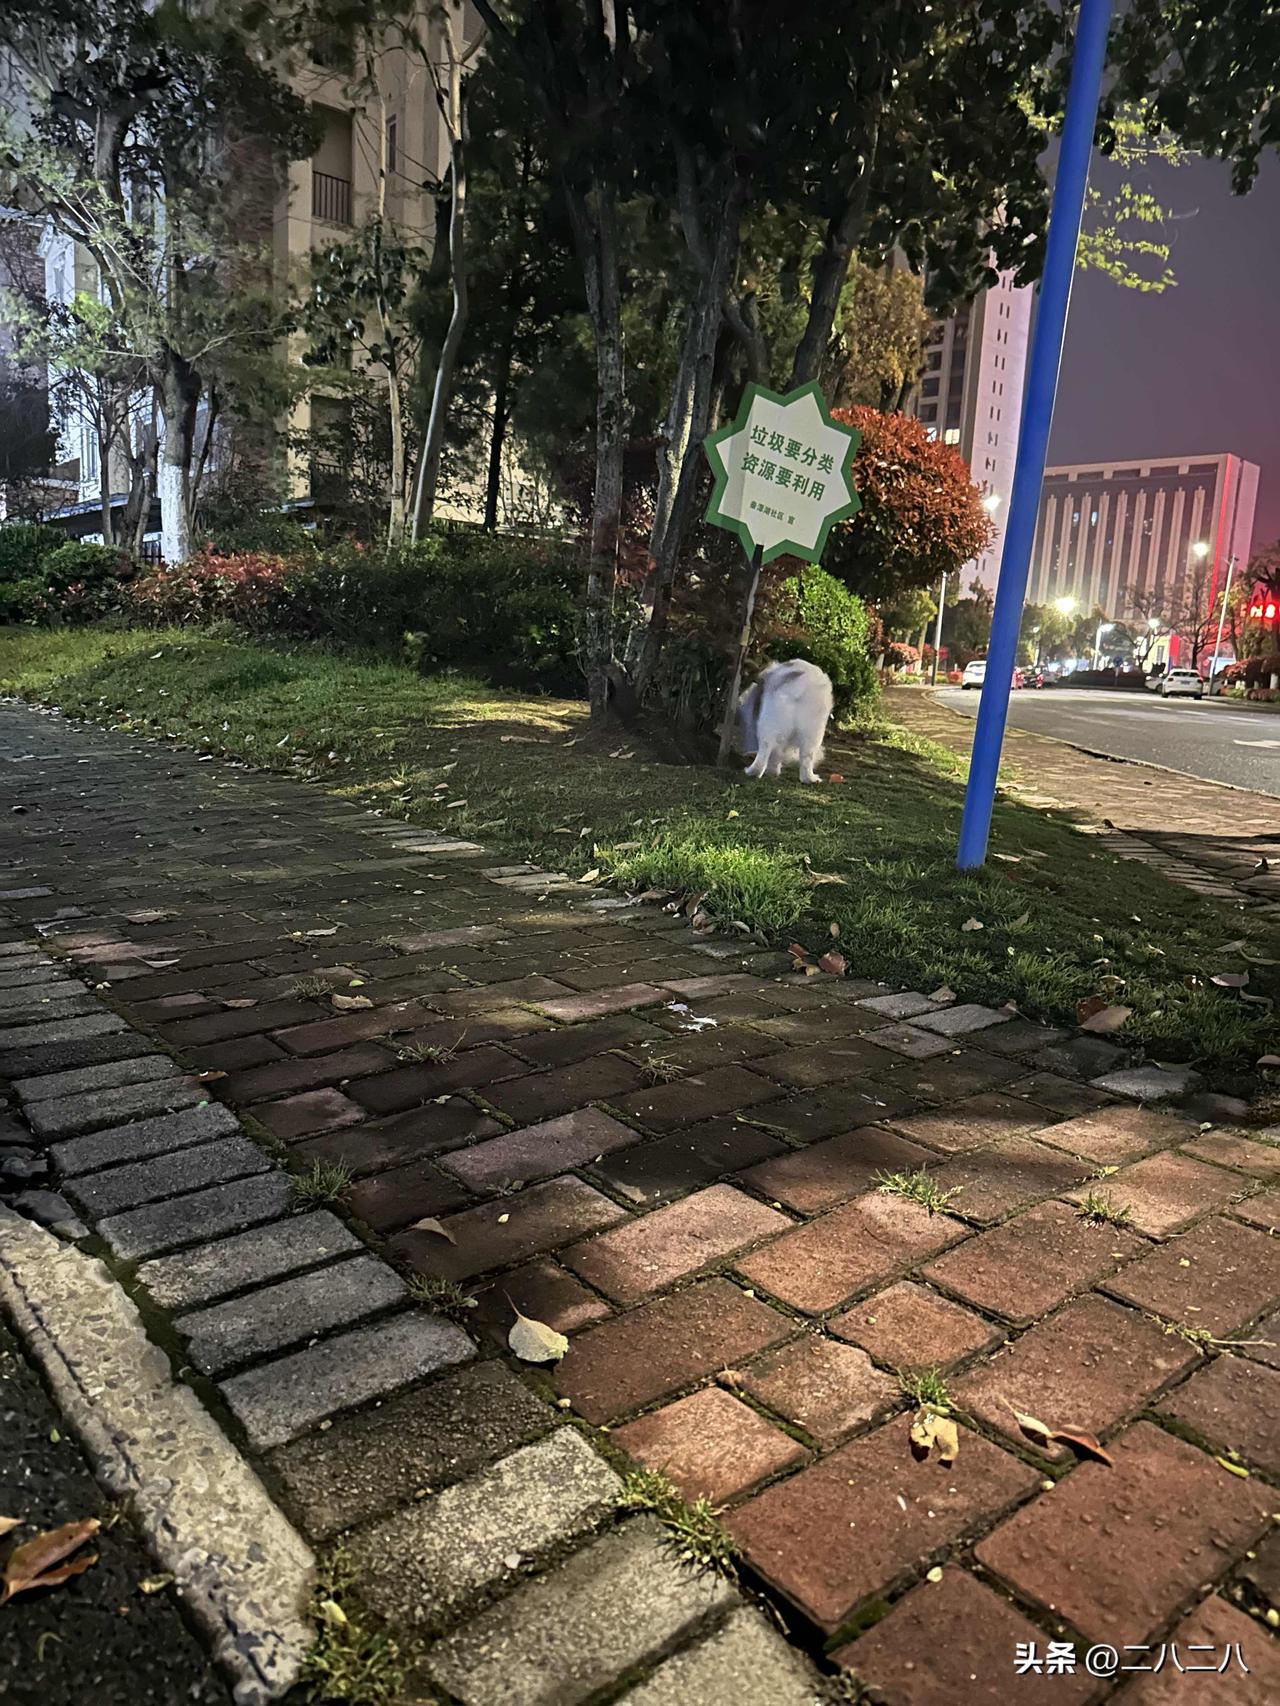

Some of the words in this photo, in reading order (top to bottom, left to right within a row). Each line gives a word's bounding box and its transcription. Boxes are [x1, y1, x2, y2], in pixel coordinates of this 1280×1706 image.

[750, 424, 834, 475] 垃圾要分类
[741, 452, 825, 501] 资源要利用
